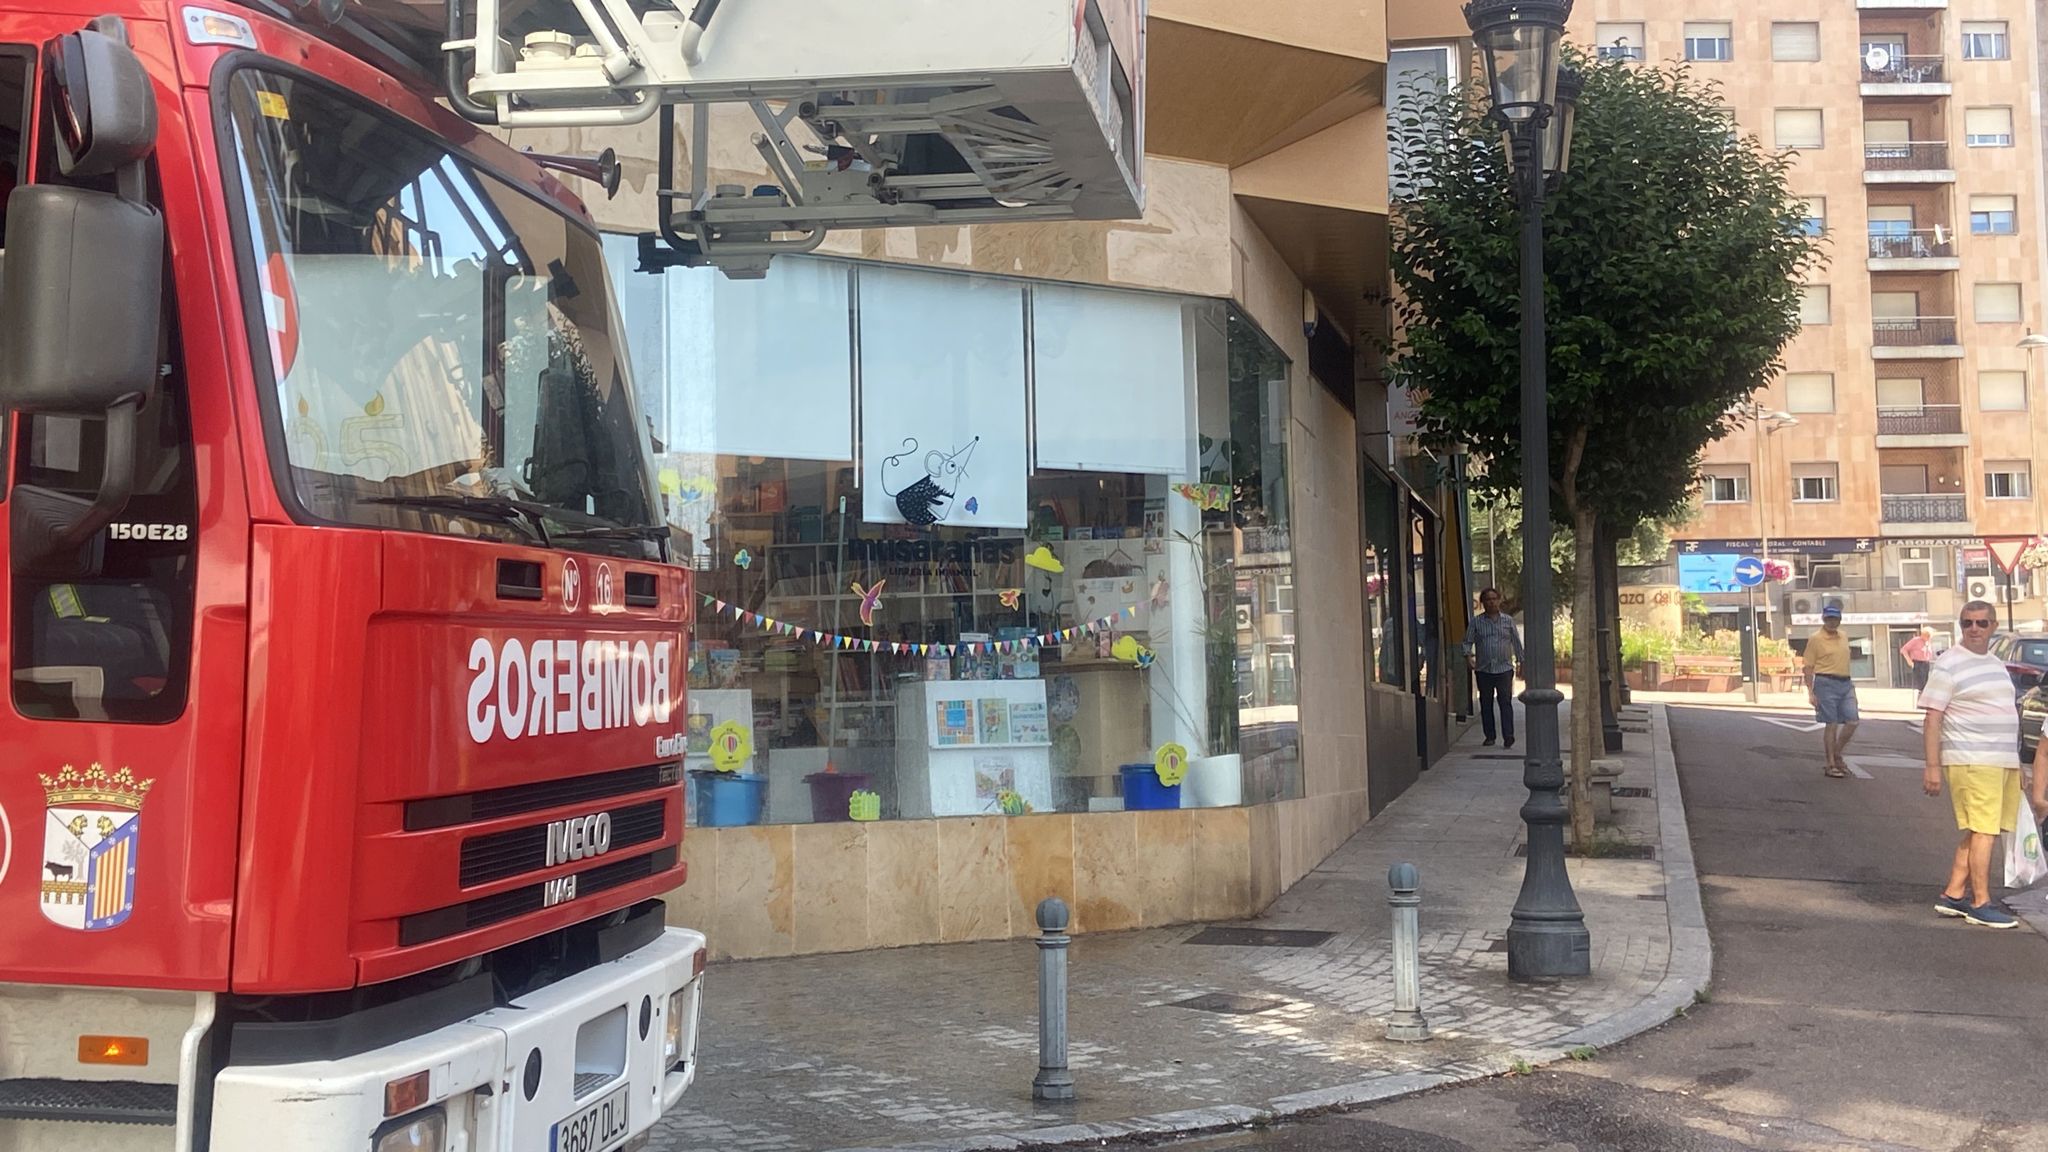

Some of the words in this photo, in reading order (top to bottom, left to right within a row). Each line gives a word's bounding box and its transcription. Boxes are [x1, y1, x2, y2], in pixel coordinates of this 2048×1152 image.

[110, 523, 188, 540] 150E28
[1887, 538, 1985, 546] LABORATORIO
[598, 573, 610, 604] 16
[1619, 593, 1645, 605] aza
[545, 812, 611, 867] IVECO
[561, 1108, 598, 1152] 3687
[602, 1091, 627, 1143] DLJ
